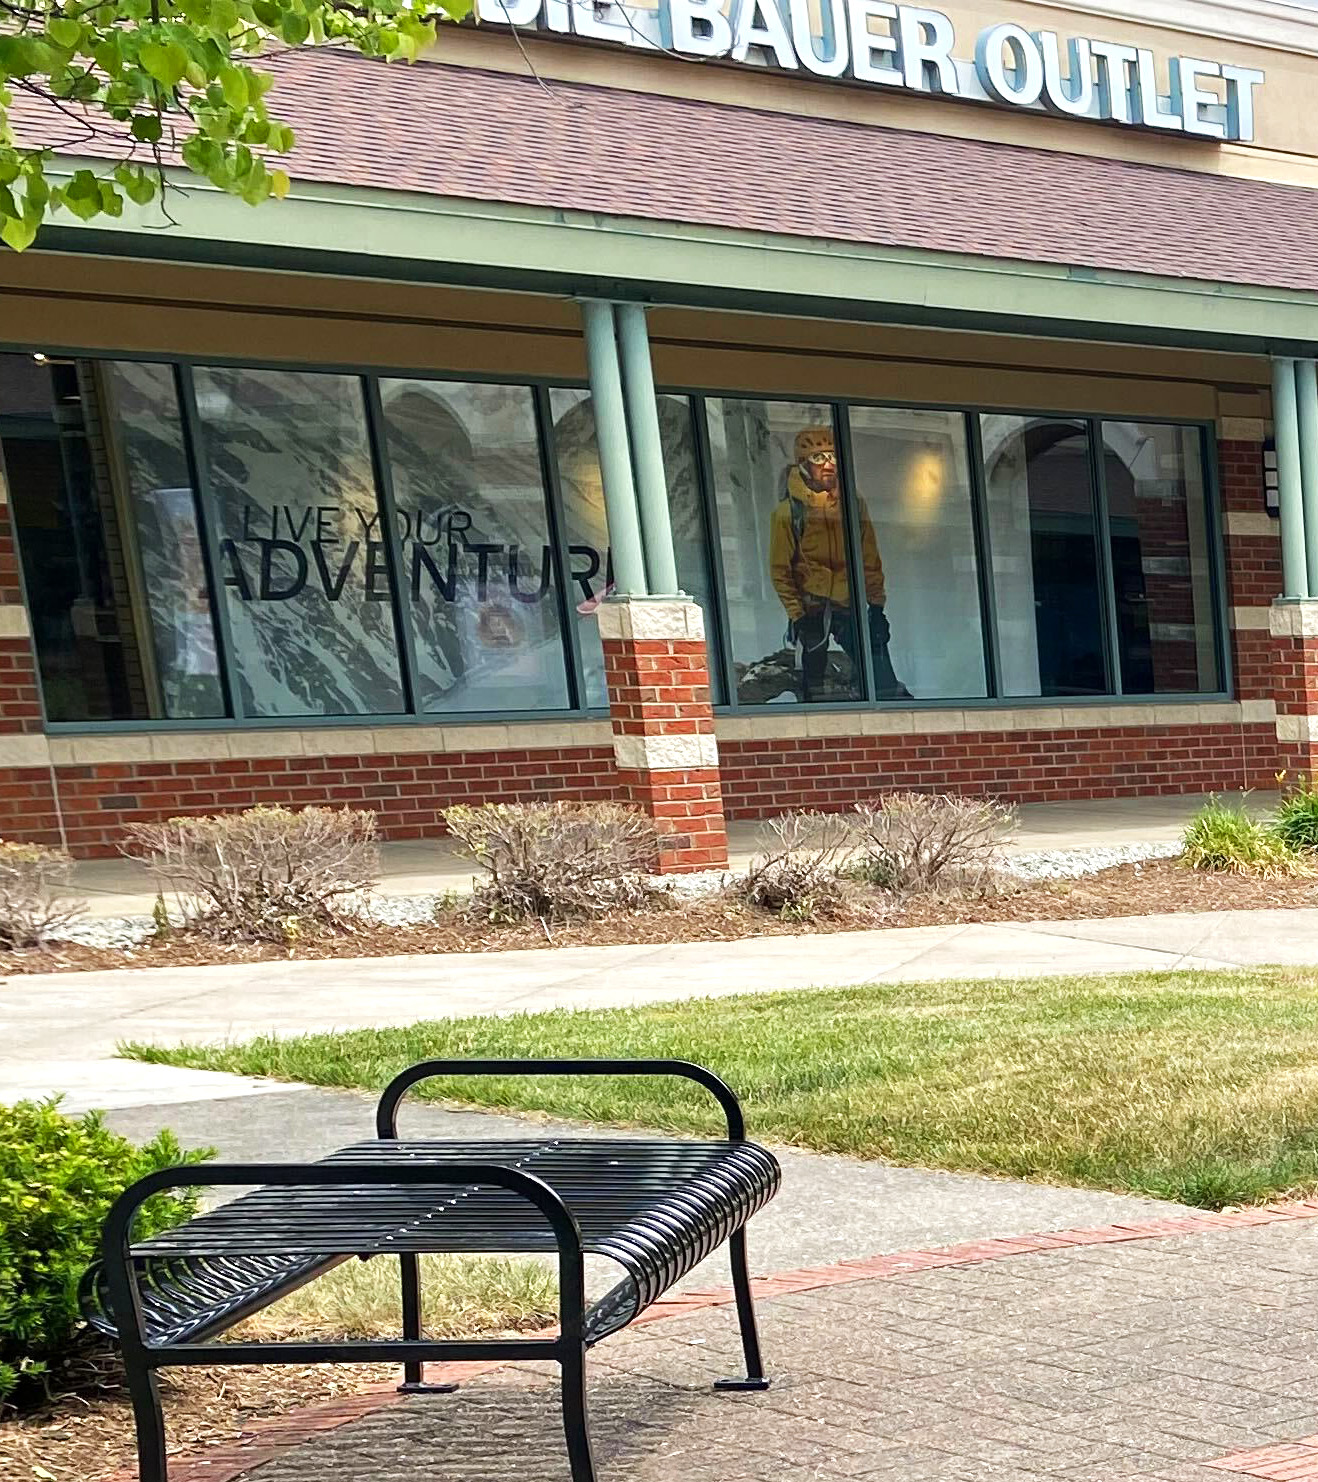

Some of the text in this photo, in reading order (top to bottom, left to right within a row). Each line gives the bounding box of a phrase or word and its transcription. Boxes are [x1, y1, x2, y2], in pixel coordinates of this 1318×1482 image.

[671, 0, 959, 96] BAUER
[976, 22, 1265, 142] OUTLET
[243, 505, 473, 547] LIVE YOUR
[219, 538, 615, 604] ADVENTUR
